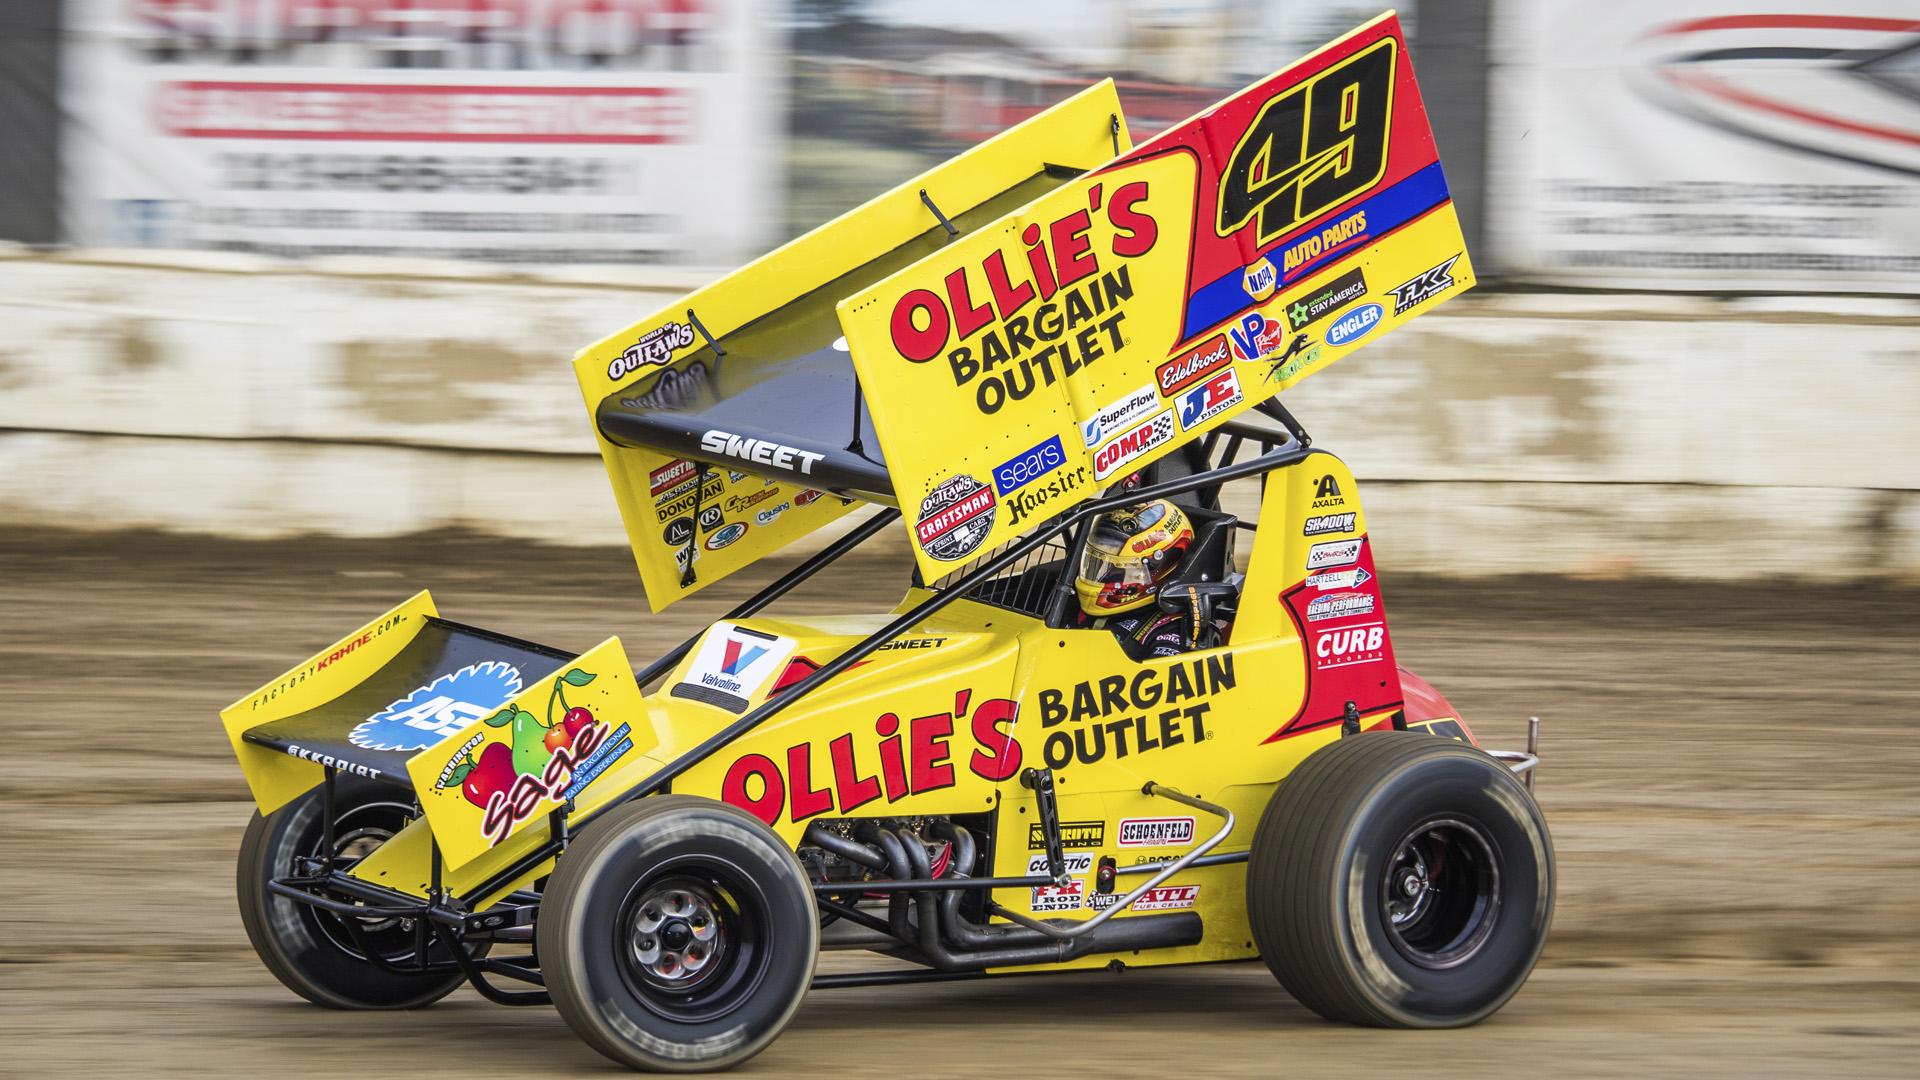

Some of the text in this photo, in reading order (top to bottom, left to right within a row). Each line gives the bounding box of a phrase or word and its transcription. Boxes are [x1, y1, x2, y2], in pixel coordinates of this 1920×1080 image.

[1215, 35, 1398, 250] 49
[1247, 210, 1367, 293] NAPA AUTO PARTS
[1308, 290, 1334, 307] extended
[1310, 281, 1364, 316] STAY AMERICA
[639, 321, 673, 344] WORLD OF
[947, 264, 1134, 387] BARGAIN
[1229, 312, 1265, 361] VP
[1331, 306, 1379, 346] ENGLER
[608, 322, 695, 380] OUTLAWS
[976, 311, 1126, 415] OUTLET
[1161, 341, 1228, 390] Edelbrock
[1099, 390, 1155, 427] SuperFlow
[1182, 371, 1235, 428] JE
[1200, 394, 1242, 420] PISTONS
[700, 429, 825, 475] SWEET
[1096, 424, 1153, 473] COMP
[1136, 432, 1168, 453] CAMS
[656, 462, 685, 486] SWEET
[1000, 444, 1060, 489] sears
[657, 481, 723, 521] DONOAN
[758, 501, 790, 521] Clausing
[922, 476, 972, 512] OUTLAWS
[1006, 466, 1086, 526] Hoosier
[1312, 498, 1344, 508] AXALTA
[920, 492, 990, 539] CRAFTSMAN
[969, 517, 986, 530] CARS
[1305, 513, 1356, 531] SHADOW
[933, 534, 953, 549] SPRINT
[1306, 573, 1341, 586] HARTZELL
[879, 638, 947, 651] SWEET
[1316, 627, 1384, 658] CURB
[1317, 651, 1383, 666] RECORDS
[701, 672, 741, 692] Valvoline
[1038, 651, 1237, 728] BARGAIN
[573, 726, 629, 780] AN EXCEPTIONAL
[1043, 702, 1211, 770] OUTLET
[435, 731, 484, 790] WASHINGTON
[566, 740, 632, 800] EATING EXPERIENCE
[1031, 827, 1102, 842] SROTH
[1123, 822, 1190, 840] SCHOENFELD
[1029, 857, 1091, 872] COETIC
[1031, 902, 1080, 911] ENDS
[1043, 895, 1081, 903] ROD
[1137, 888, 1196, 903] ATL
[1161, 901, 1193, 909] CELLS
